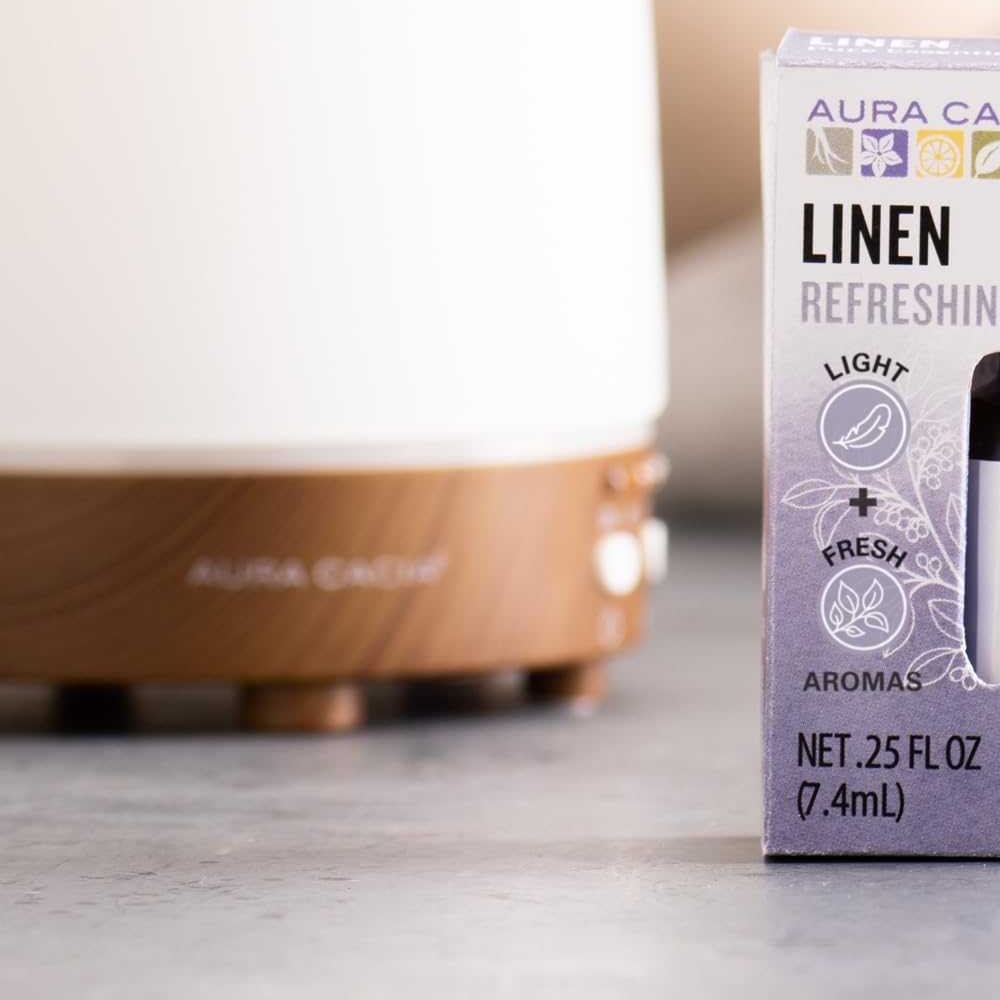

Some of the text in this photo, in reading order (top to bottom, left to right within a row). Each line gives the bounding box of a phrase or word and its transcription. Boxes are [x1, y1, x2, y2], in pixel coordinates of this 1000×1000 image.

[808, 36, 951, 49] LINEN
[807, 99, 928, 124] AURA
[802, 203, 951, 266] LINEN
[824, 352, 909, 382] LIGHT
[822, 537, 908, 568] FRESH
[803, 671, 922, 692] AROMAS
[798, 732, 981, 770] NET .25 FL OZ
[797, 780, 904, 823] (7.4mL)
